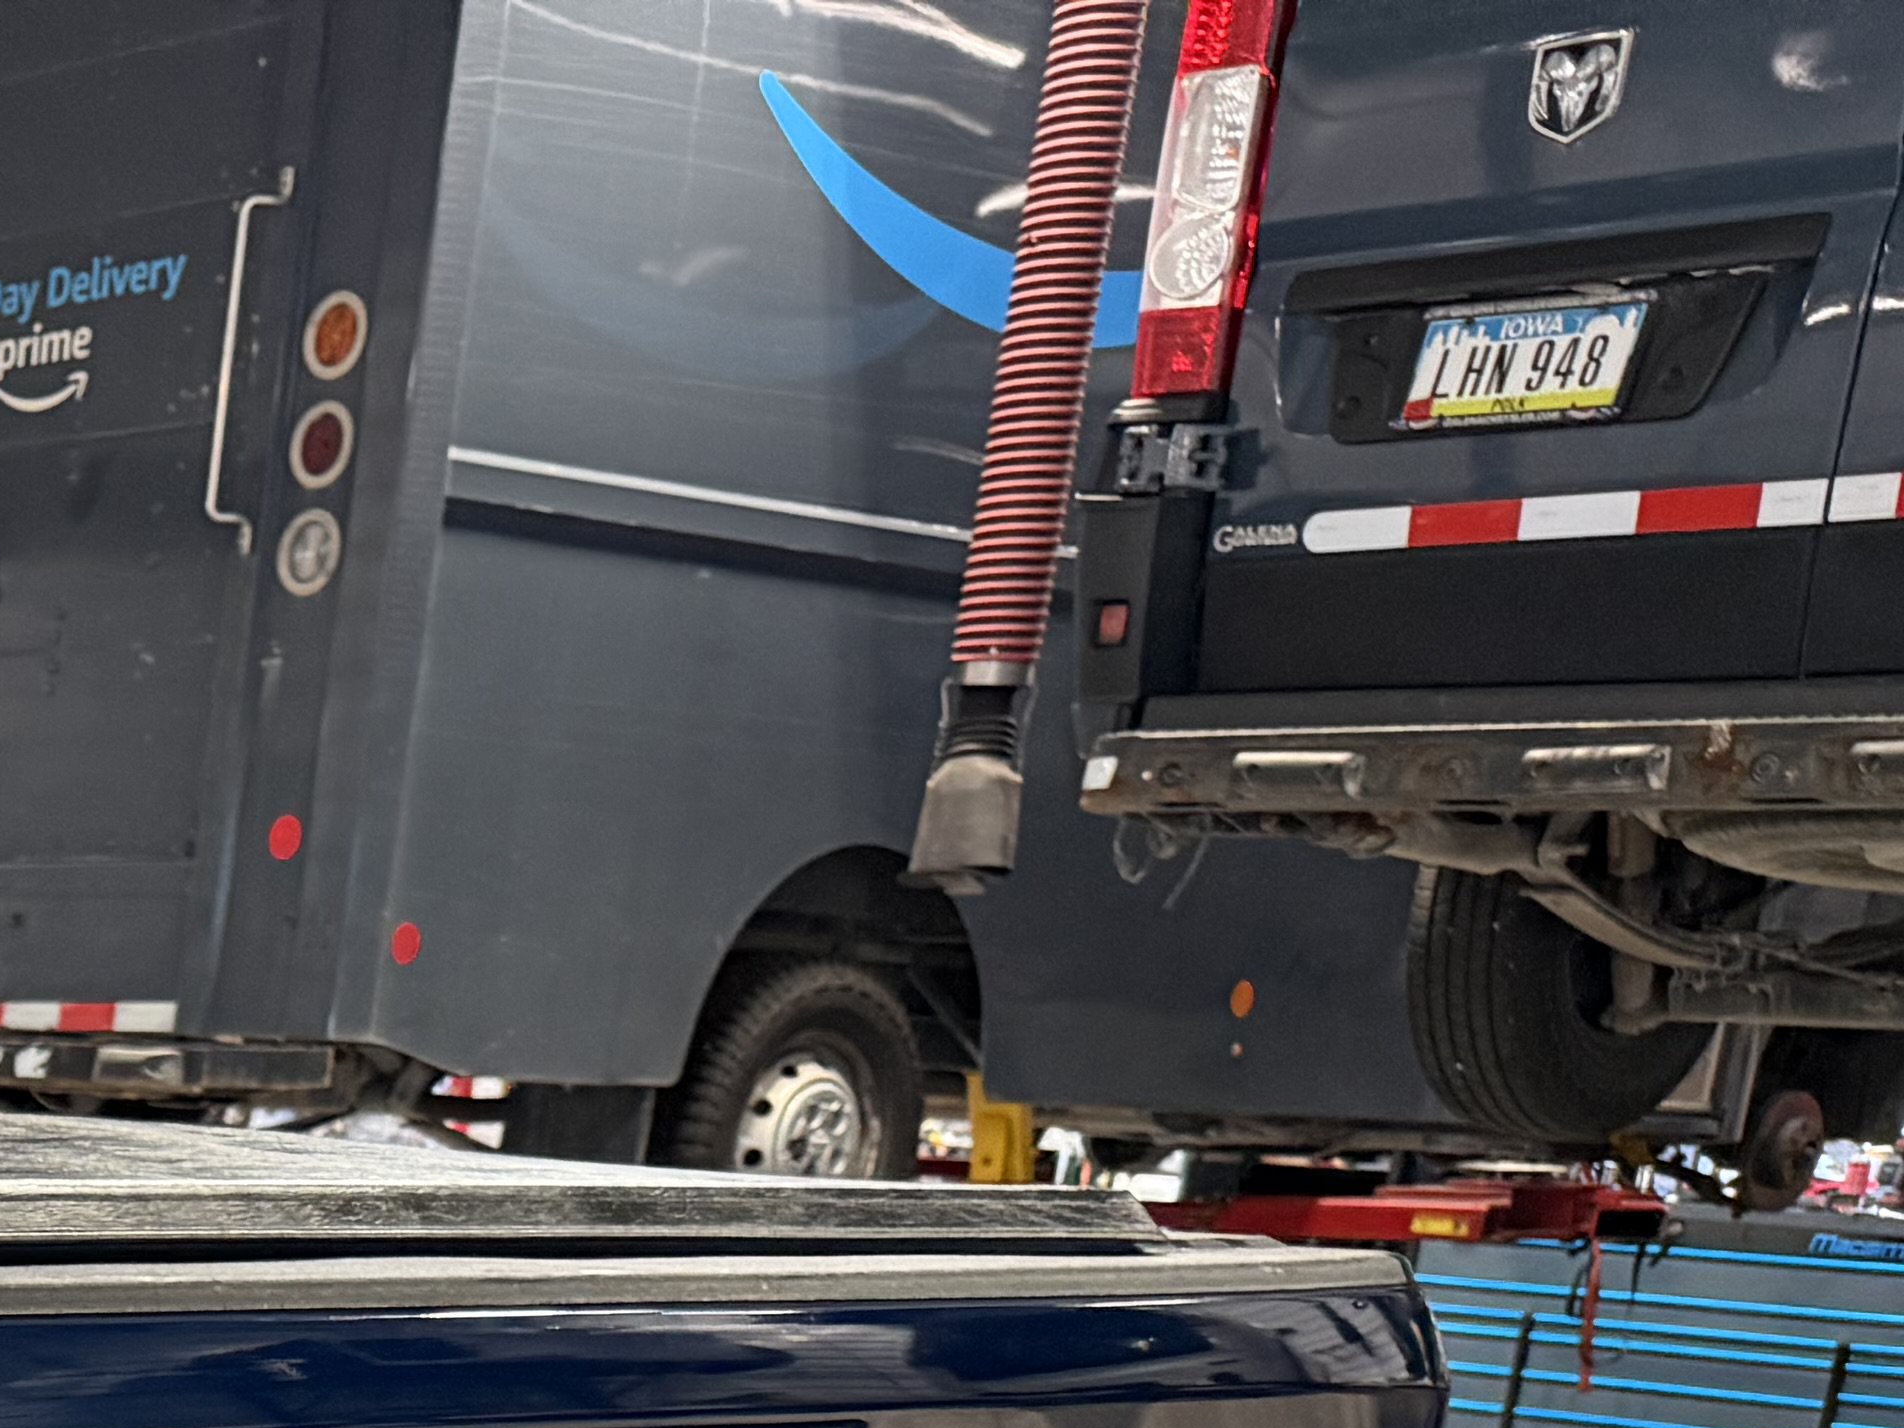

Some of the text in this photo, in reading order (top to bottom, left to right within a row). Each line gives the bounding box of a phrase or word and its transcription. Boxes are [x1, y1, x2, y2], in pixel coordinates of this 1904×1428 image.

[46, 252, 188, 308] Delivery
[1499, 314, 1564, 340] IOWA
[1431, 333, 1610, 399] LHN 948
